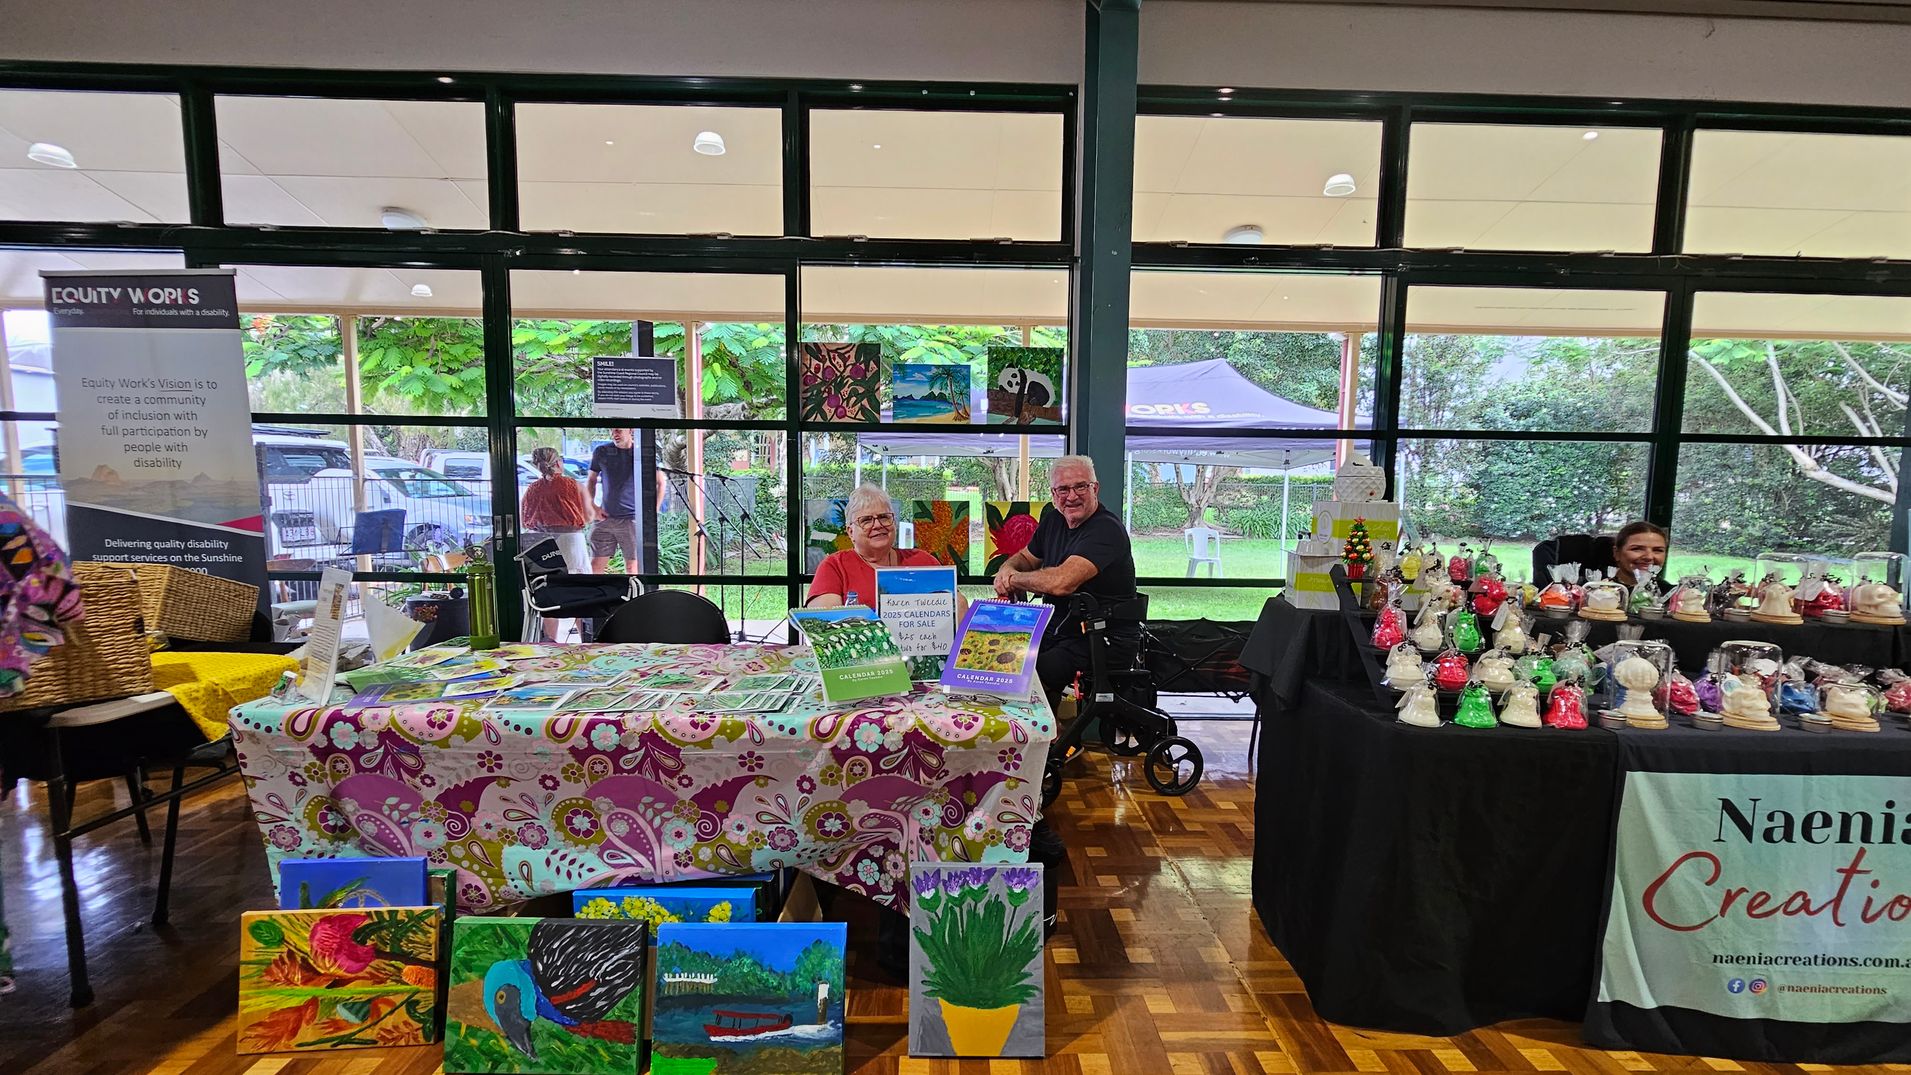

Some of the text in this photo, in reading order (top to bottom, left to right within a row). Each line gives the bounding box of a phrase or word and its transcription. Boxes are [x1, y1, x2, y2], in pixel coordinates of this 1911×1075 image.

[51, 287, 200, 304] EQUITY WORKS
[144, 308, 178, 316] individuals
[179, 308, 194, 316] with
[201, 308, 230, 317] disability.
[81, 378, 218, 390] Equity Work's Vision is to
[97, 395, 206, 407] create a community
[1126, 402, 1211, 415] ORKS
[108, 410, 198, 420] of inclusion with
[101, 425, 208, 439] full participation by
[124, 442, 188, 454] people with
[133, 457, 182, 470] disability
[104, 538, 229, 550] Delivering quality disability
[92, 553, 129, 562] support
[130, 553, 168, 562] services
[184, 553, 199, 562] the
[201, 553, 243, 563] Sunshine
[887, 598, 948, 606] Karen Tweedie
[883, 610, 951, 619] 2025 CALENDARS
[899, 620, 915, 628] FOR
[917, 643, 927, 651] for
[932, 642, 948, 650] $40
[839, 671, 875, 680] CALENDAR
[957, 673, 994, 682] CALENDAR
[1777, 984, 1888, 995] @naeniacreations
